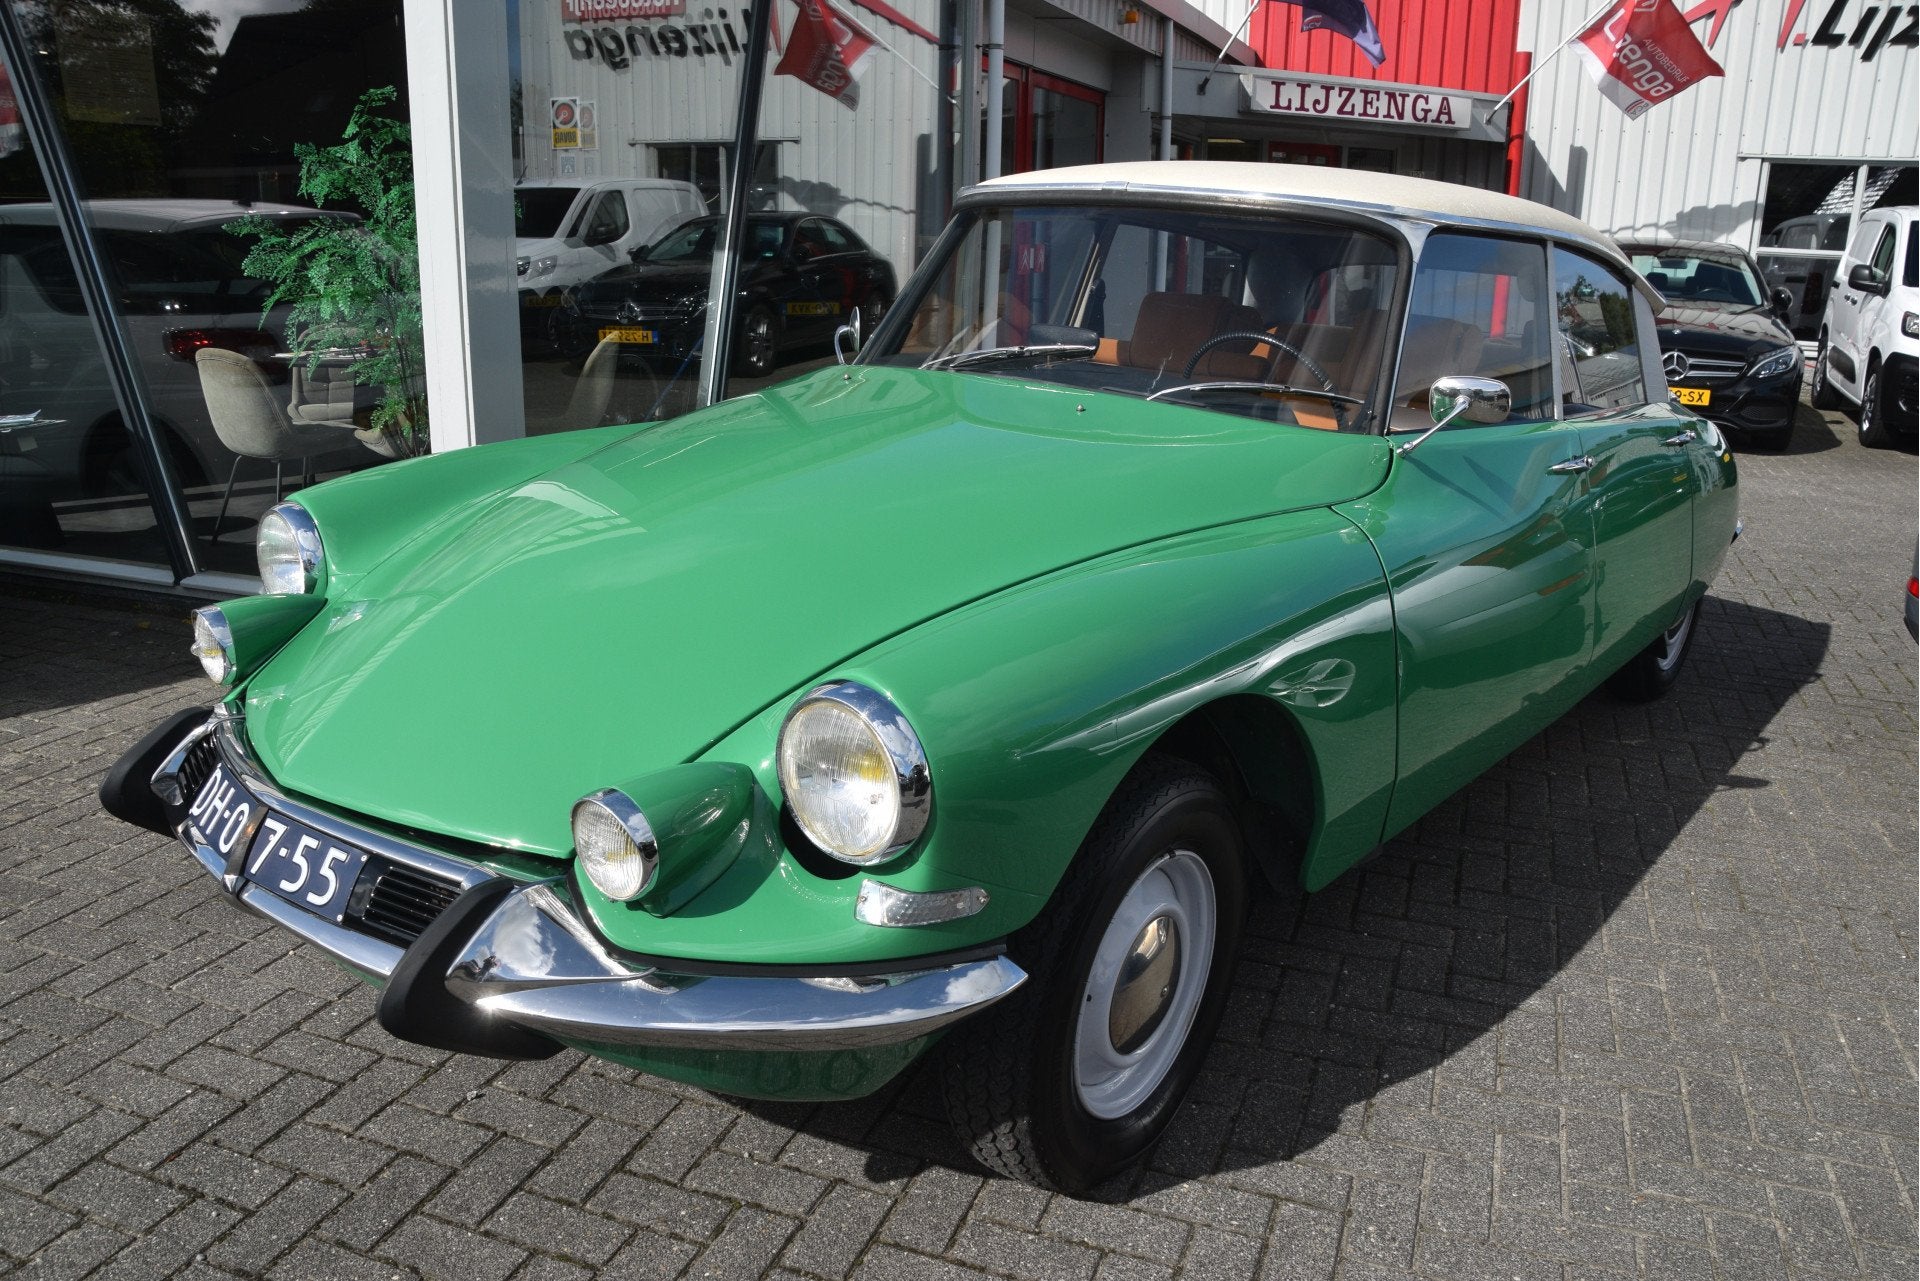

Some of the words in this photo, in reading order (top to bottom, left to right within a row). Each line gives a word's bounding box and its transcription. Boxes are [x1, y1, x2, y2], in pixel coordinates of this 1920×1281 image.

[1643, 38, 1690, 84] AUTOBEDRIJF
[1269, 80, 1455, 125] LIJZENGA
[1672, 389, 1704, 403] 9-SX
